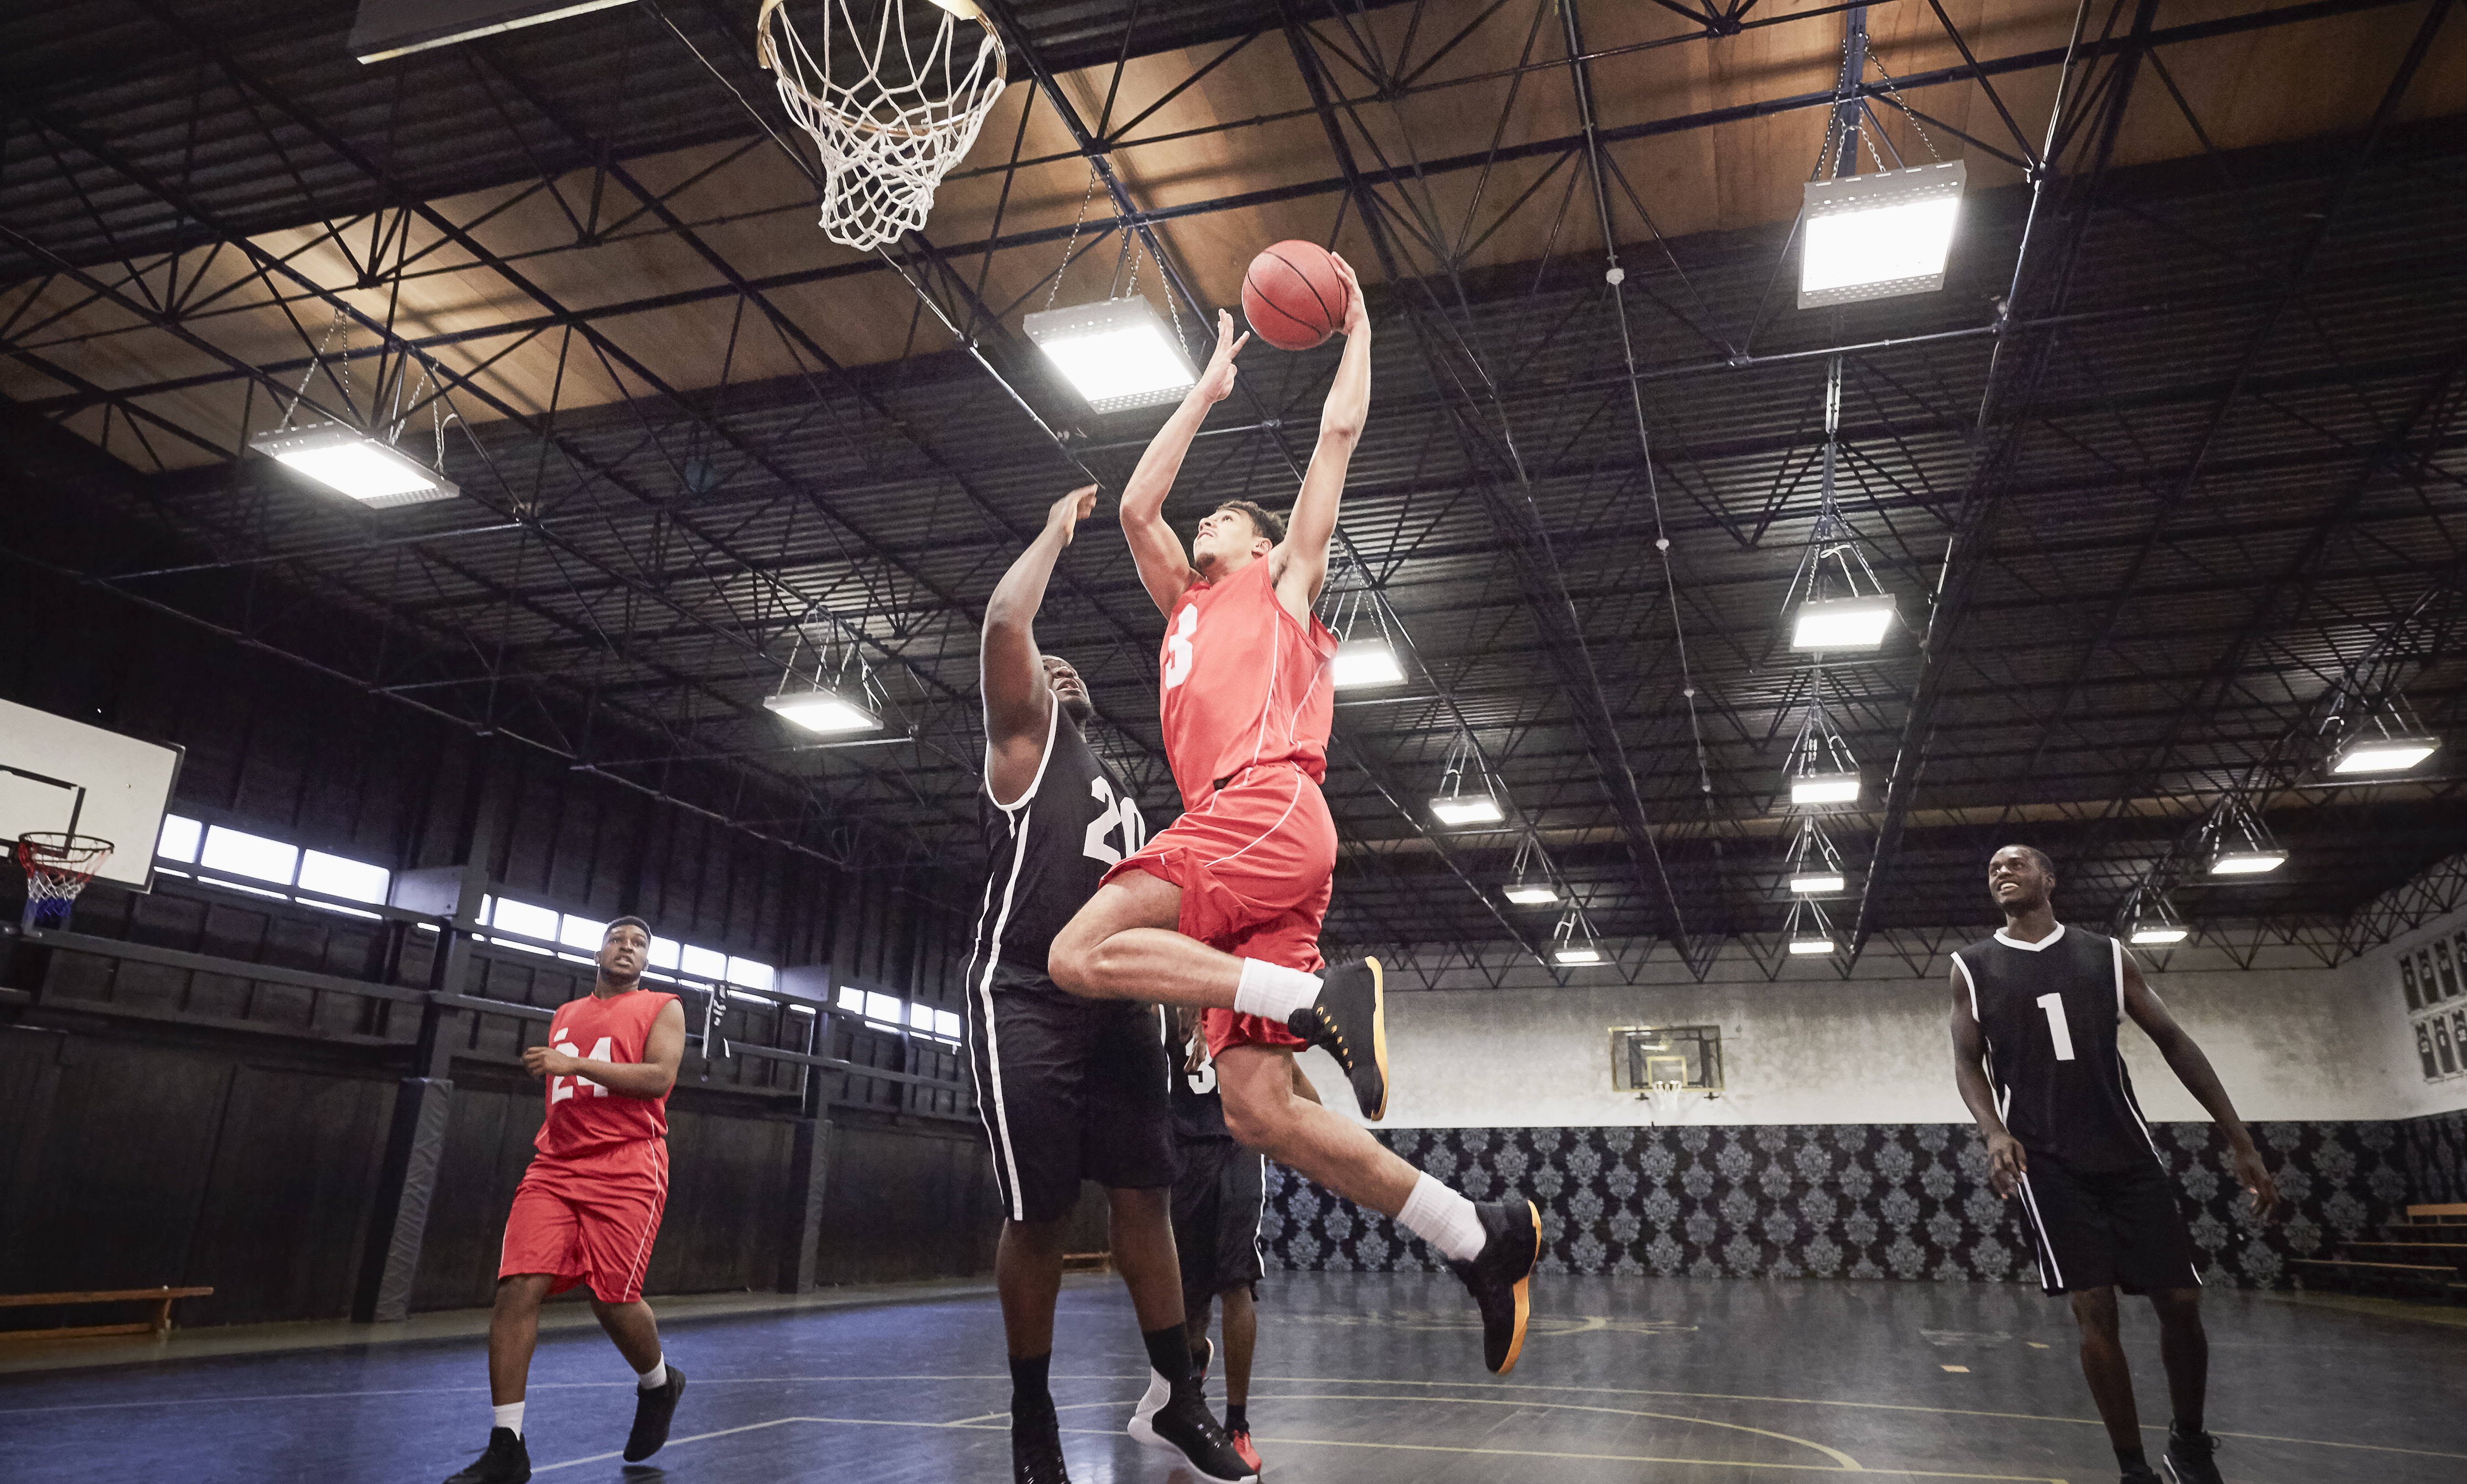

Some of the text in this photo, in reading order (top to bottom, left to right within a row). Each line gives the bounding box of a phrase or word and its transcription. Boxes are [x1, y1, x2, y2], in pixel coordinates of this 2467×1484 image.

[1165, 603, 1197, 690] 3
[1083, 775, 1146, 865] 20
[2036, 993, 2075, 1060] 1
[552, 1027, 611, 1104] 24
[1185, 1038, 1216, 1095] 3
